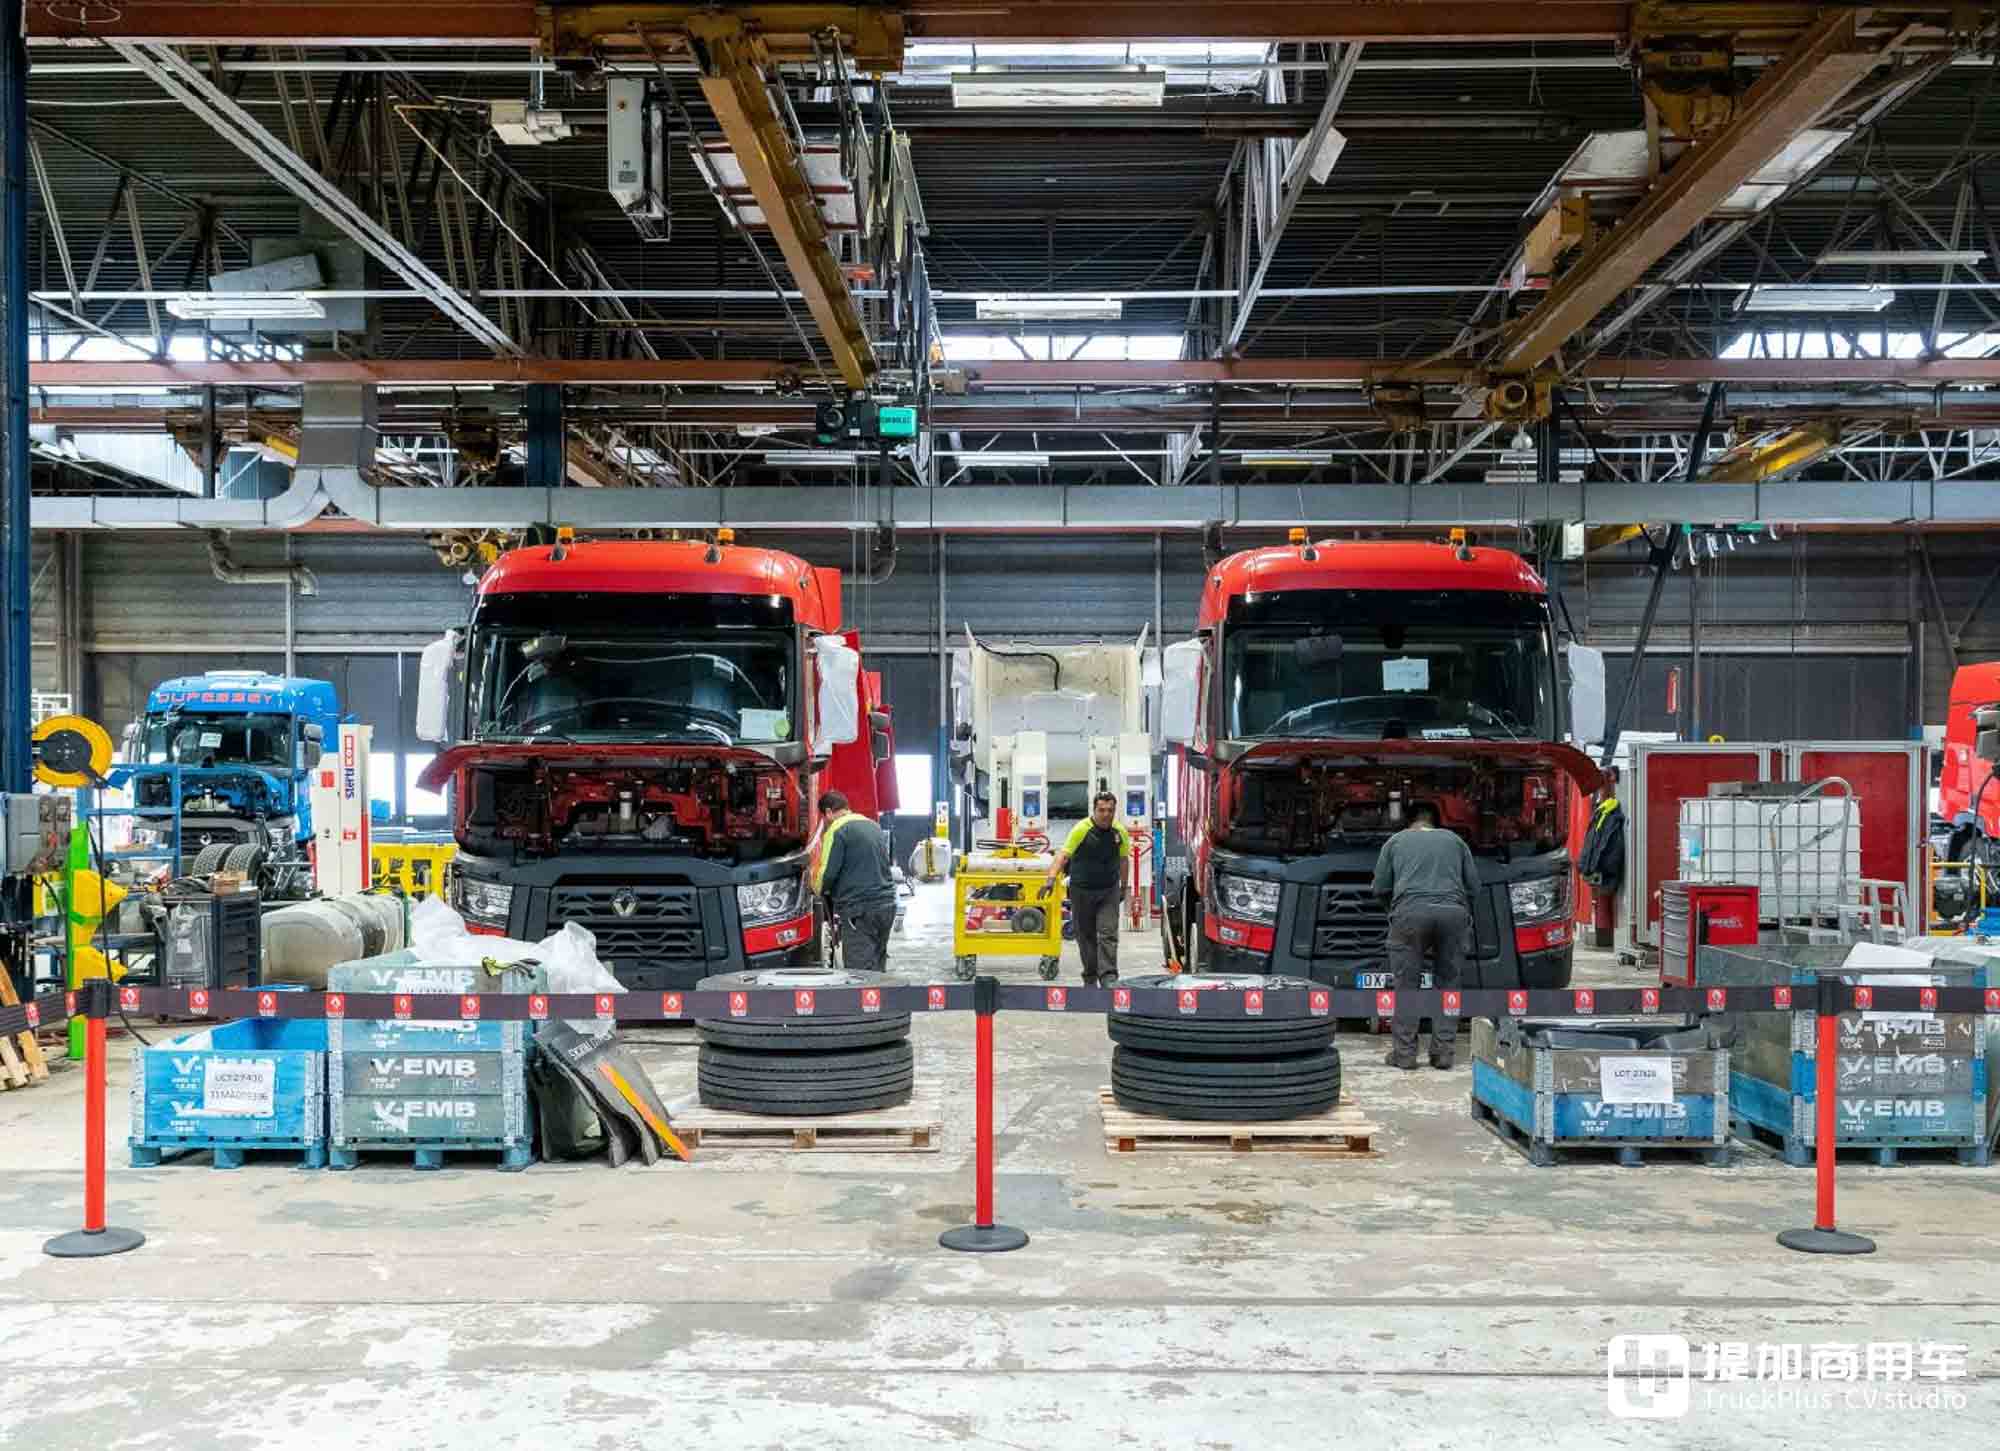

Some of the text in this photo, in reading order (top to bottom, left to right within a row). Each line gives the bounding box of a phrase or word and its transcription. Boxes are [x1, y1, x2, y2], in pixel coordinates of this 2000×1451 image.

[372, 1058, 477, 1076] V-EMB
[1841, 1056, 1946, 1073] V-EMB
[373, 1101, 477, 1118] V-EMB
[1581, 1101, 1687, 1119] V-EMB
[1841, 1099, 1946, 1117] V-EMB
